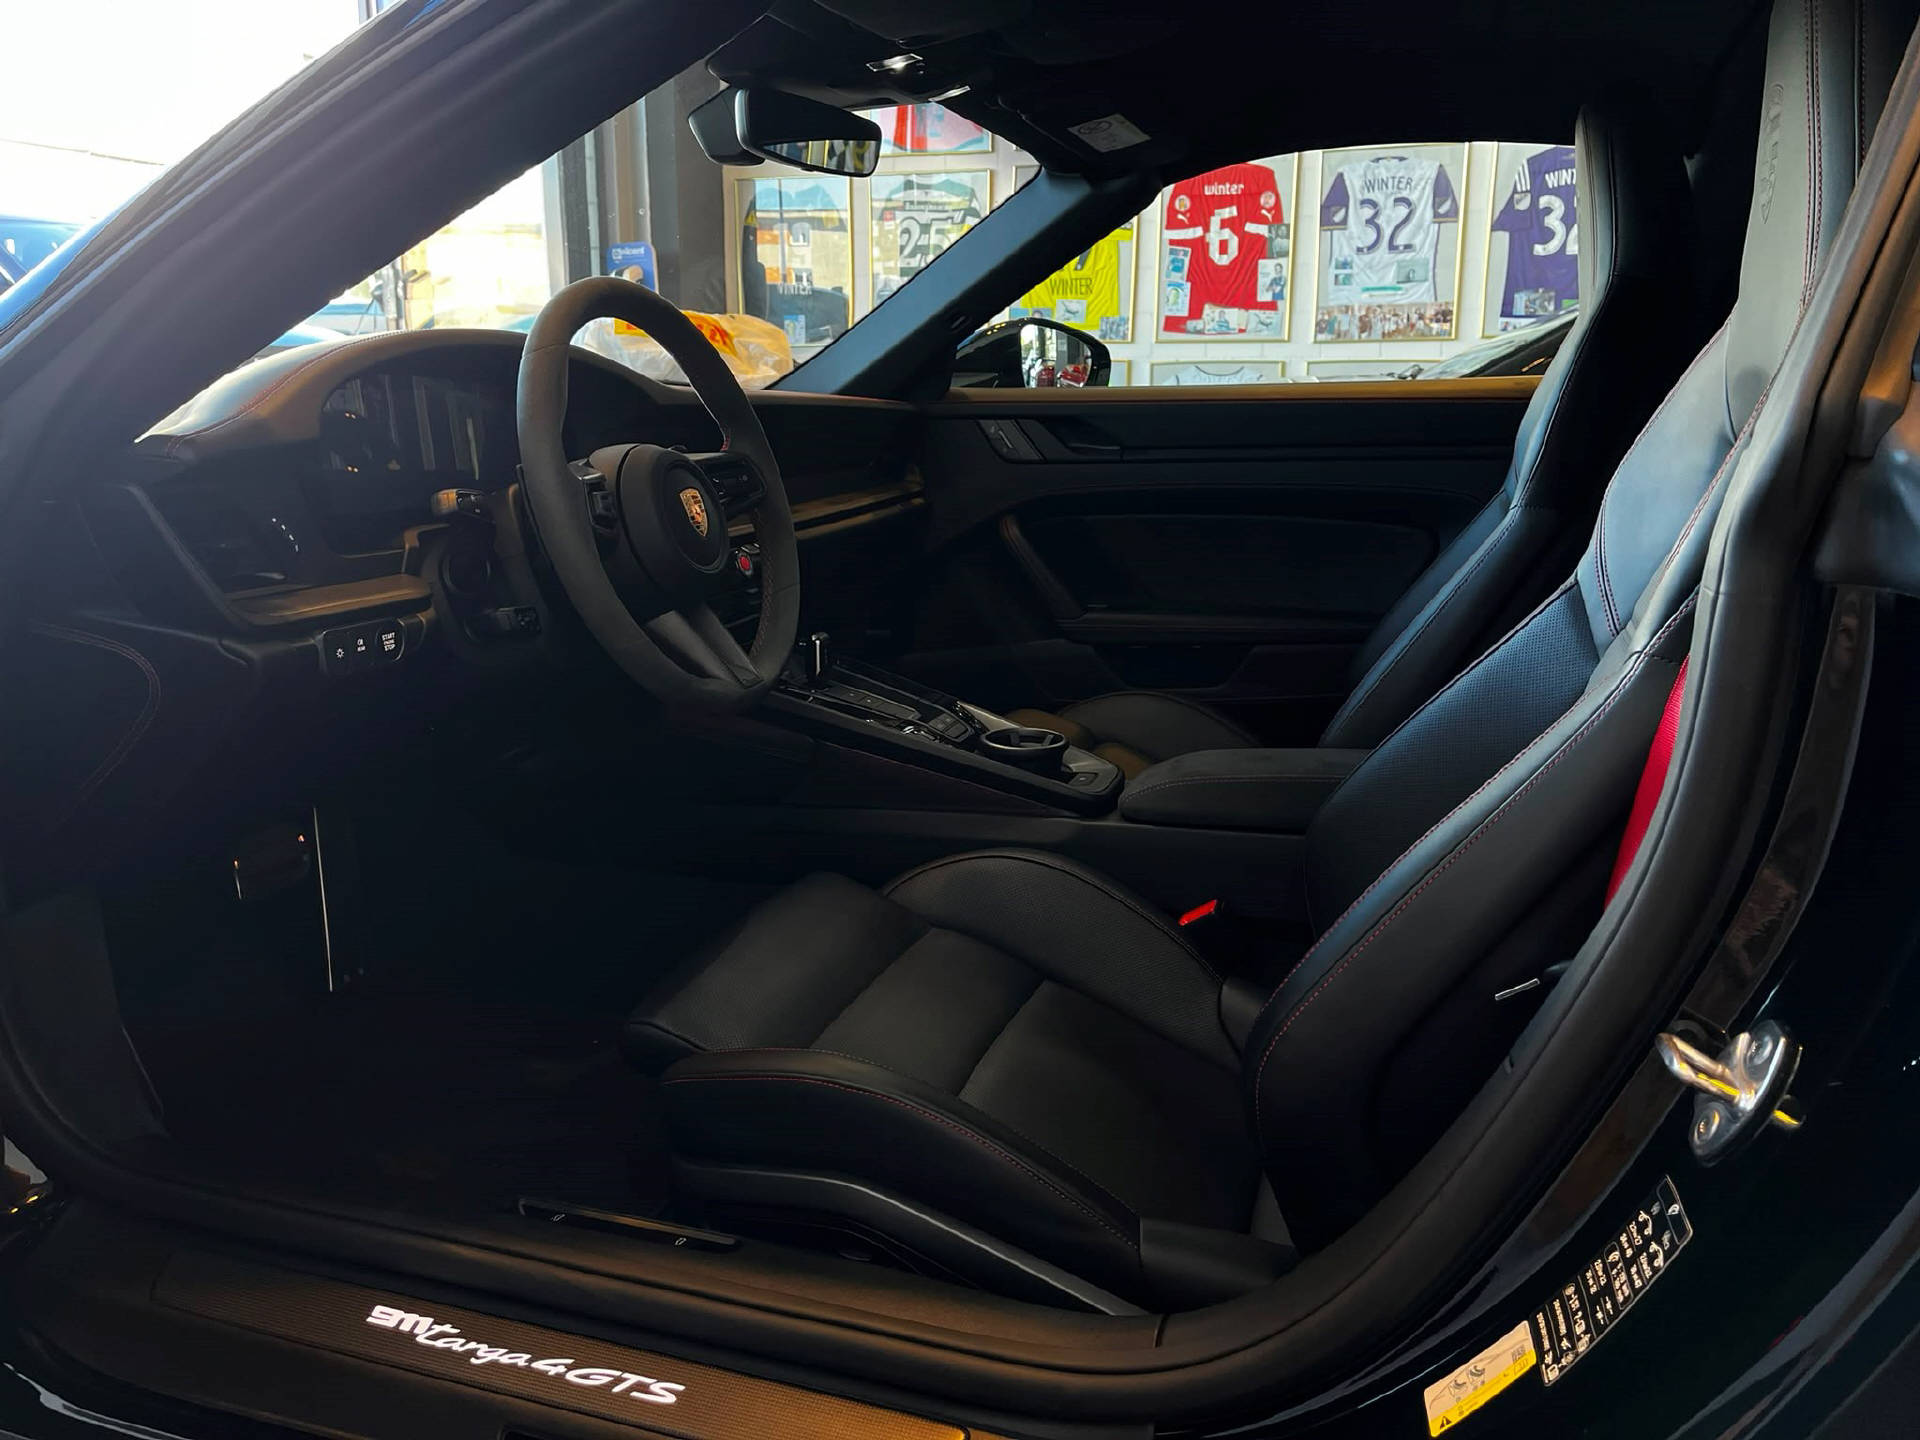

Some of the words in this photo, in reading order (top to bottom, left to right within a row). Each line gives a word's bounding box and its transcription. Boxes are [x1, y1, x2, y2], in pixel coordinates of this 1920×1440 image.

[1204, 182, 1245, 196] winter
[1364, 175, 1414, 193] WINTER
[1206, 205, 1239, 266] 6
[1356, 197, 1417, 255] 32
[1049, 277, 1093, 296] WINTER
[366, 1305, 434, 1334] 911
[415, 1323, 531, 1365] targa
[565, 1367, 686, 1404] GTS
